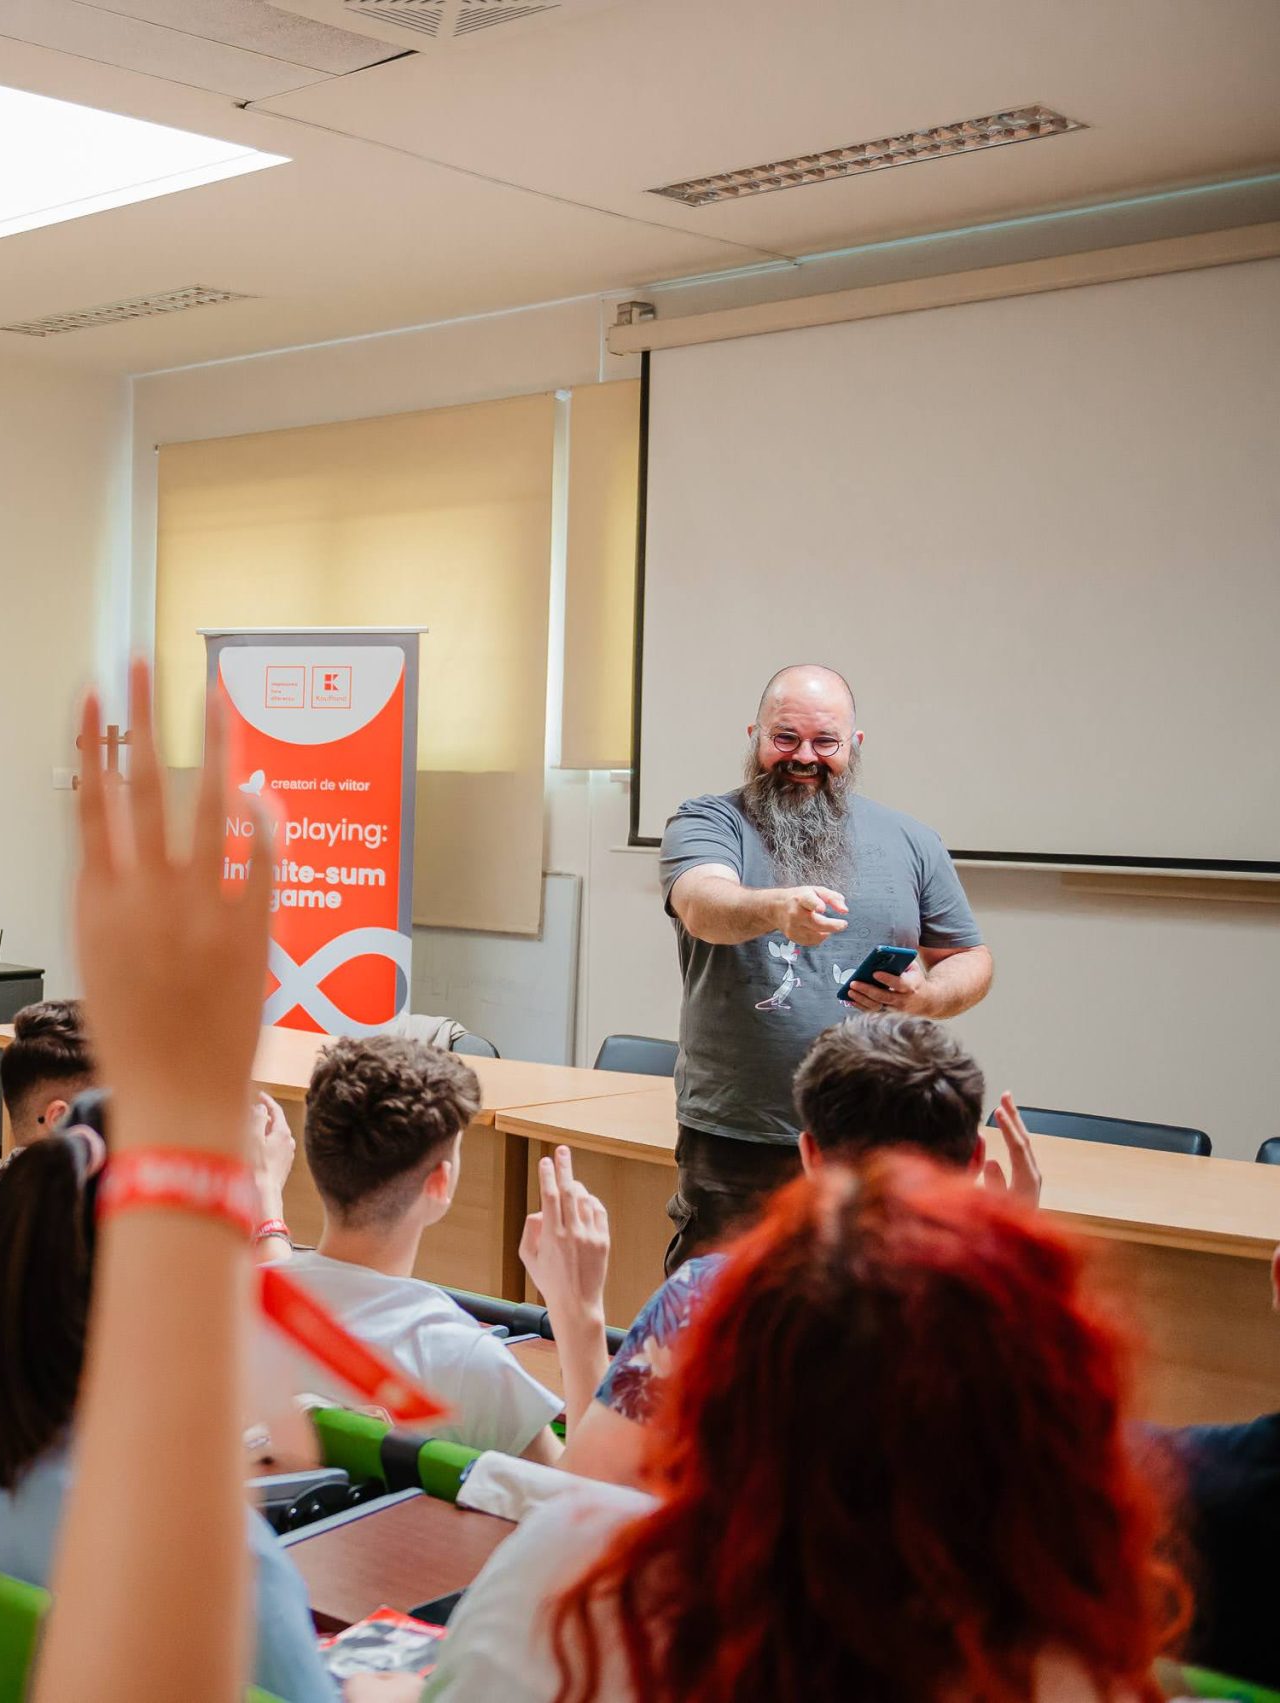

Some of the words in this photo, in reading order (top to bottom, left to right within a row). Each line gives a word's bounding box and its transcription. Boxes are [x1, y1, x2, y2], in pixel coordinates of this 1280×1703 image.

[271, 779, 317, 790] creatori
[320, 779, 336, 790] de
[339, 779, 370, 791] viitor
[285, 817, 388, 849] playing:
